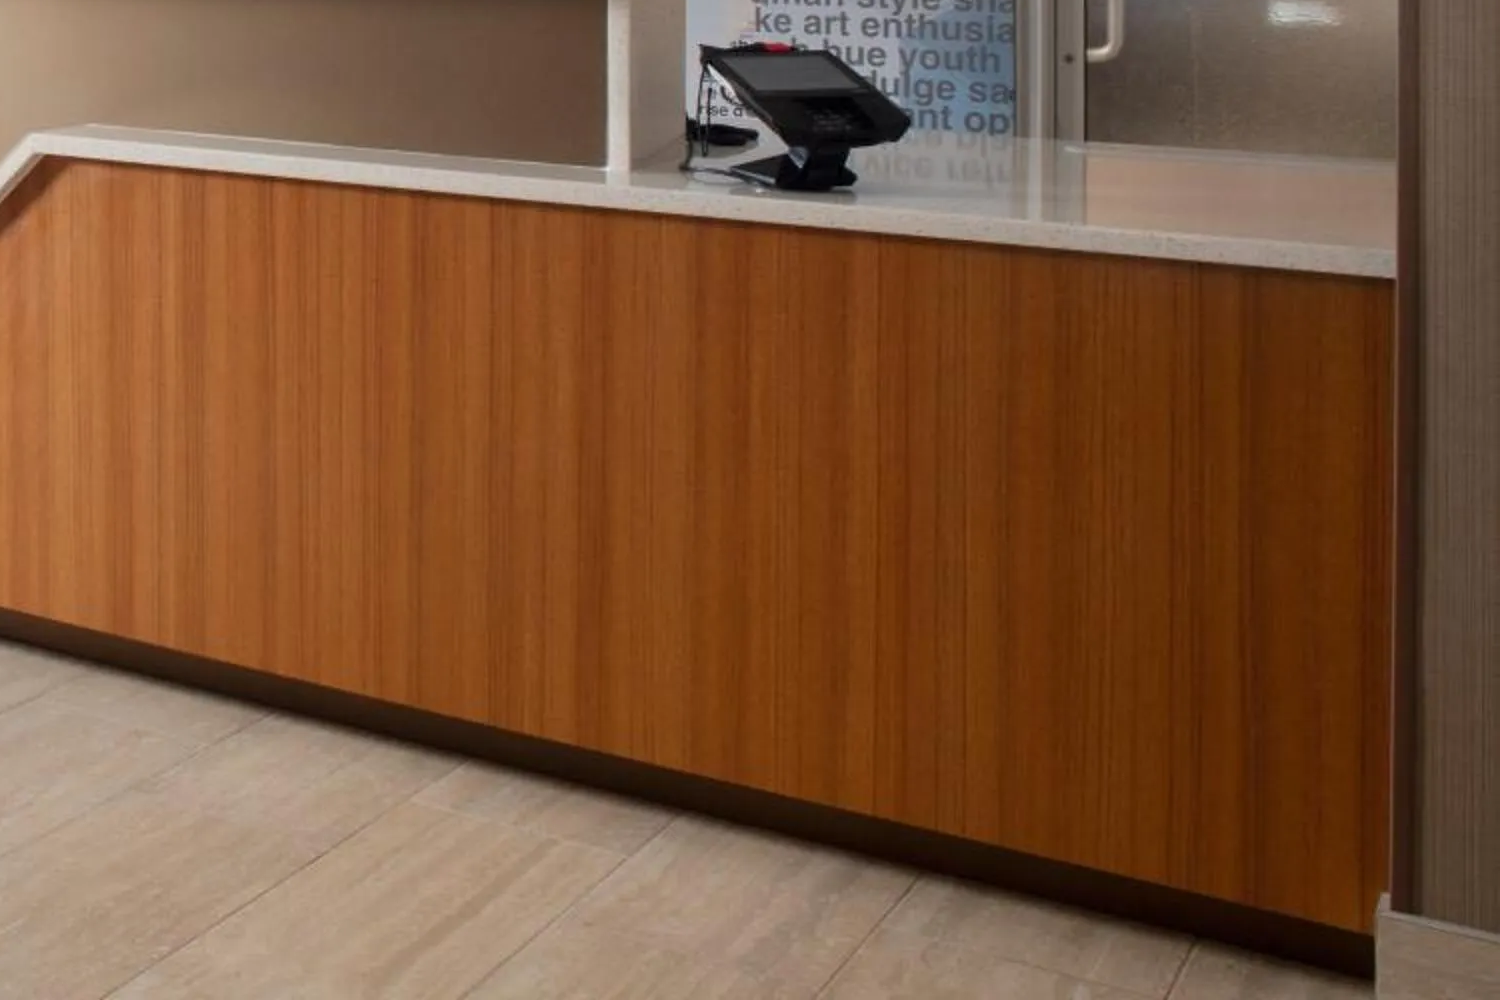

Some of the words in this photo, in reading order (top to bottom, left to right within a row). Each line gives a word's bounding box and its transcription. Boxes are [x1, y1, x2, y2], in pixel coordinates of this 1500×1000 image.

[755, 6, 792, 33] ke
[803, 11, 850, 36] art
[861, 13, 1014, 42] enthusia
[898, 45, 1000, 74] youth
